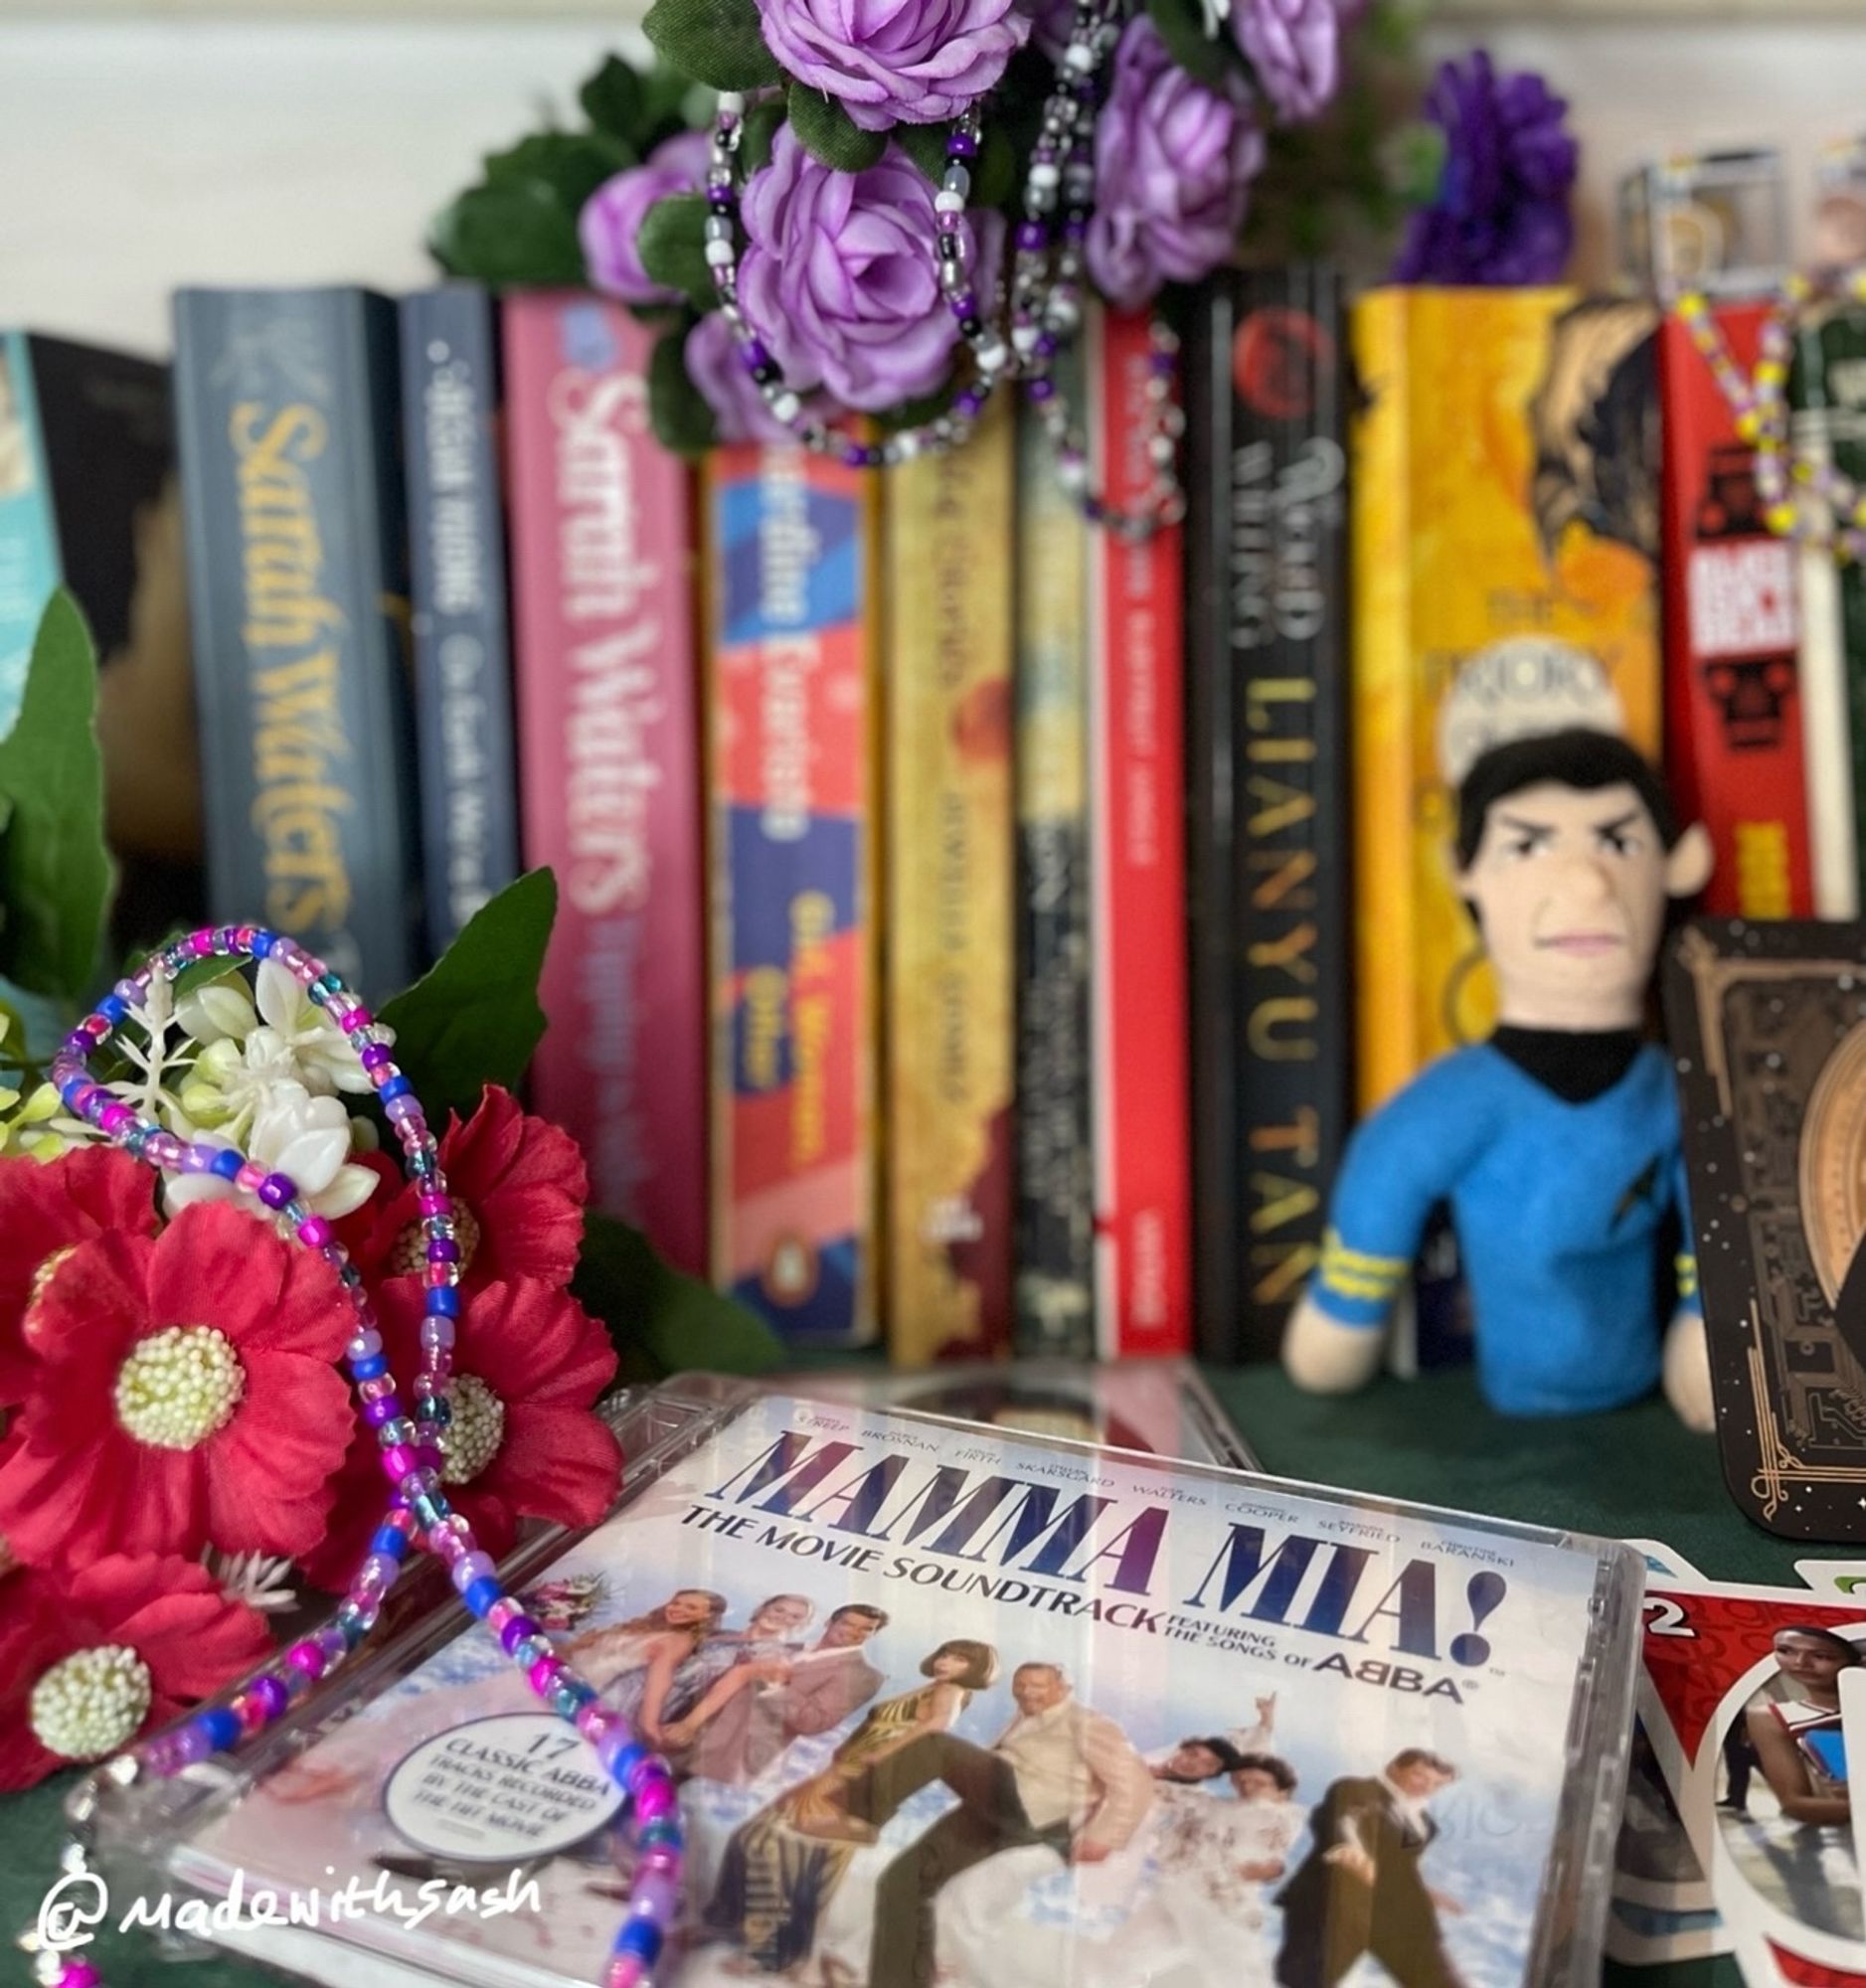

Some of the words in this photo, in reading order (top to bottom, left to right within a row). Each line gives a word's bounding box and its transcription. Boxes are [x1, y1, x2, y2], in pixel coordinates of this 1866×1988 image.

[229, 402, 348, 647] Sarah
[548, 365, 660, 620] Sarah
[252, 644, 352, 932] Waters
[567, 622, 666, 916] Waters
[759, 632, 821, 843] Evaristo
[1246, 677, 1318, 1061] LIANYU
[1250, 1105, 1319, 1305] TAN
[704, 1429, 1169, 1595] MAMMA
[1182, 1523, 1507, 1667] MIA!
[795, 1416, 850, 1432] STREEP
[861, 1429, 940, 1454] BROSNAN
[955, 1448, 1002, 1466] FIRTH
[1132, 1484, 1208, 1507] WALTERS
[1225, 1503, 1298, 1524] COOPER
[1317, 1521, 1402, 1544] SEYFRIED
[1420, 1541, 1515, 1568] BARANSKI
[681, 1504, 760, 1541] THE
[755, 1525, 883, 1573] MOVIE
[883, 1557, 1168, 1635] SOUNDTRACK
[1167, 1614, 1276, 1648] FEATURING
[1642, 1596, 1696, 1637] 2
[1163, 1626, 1200, 1644] THE
[1206, 1635, 1277, 1660] SONGS
[1283, 1654, 1314, 1669] OF
[1313, 1651, 1464, 1704] ABBA
[414, 1790, 446, 1809] THE
[449, 1799, 482, 1819] HIT
[486, 1812, 549, 1839] MOVIE
[423, 1772, 444, 1788] BY
[453, 1781, 484, 1800] THE
[490, 1789, 538, 1814] CAST
[540, 1806, 569, 1823] OF
[429, 1752, 495, 1782] TRACKS
[498, 1774, 596, 1812] RECORDED
[445, 1738, 542, 1775] CLASSIC
[545, 1765, 611, 1797] ABBA
[527, 1732, 580, 1759] 17
